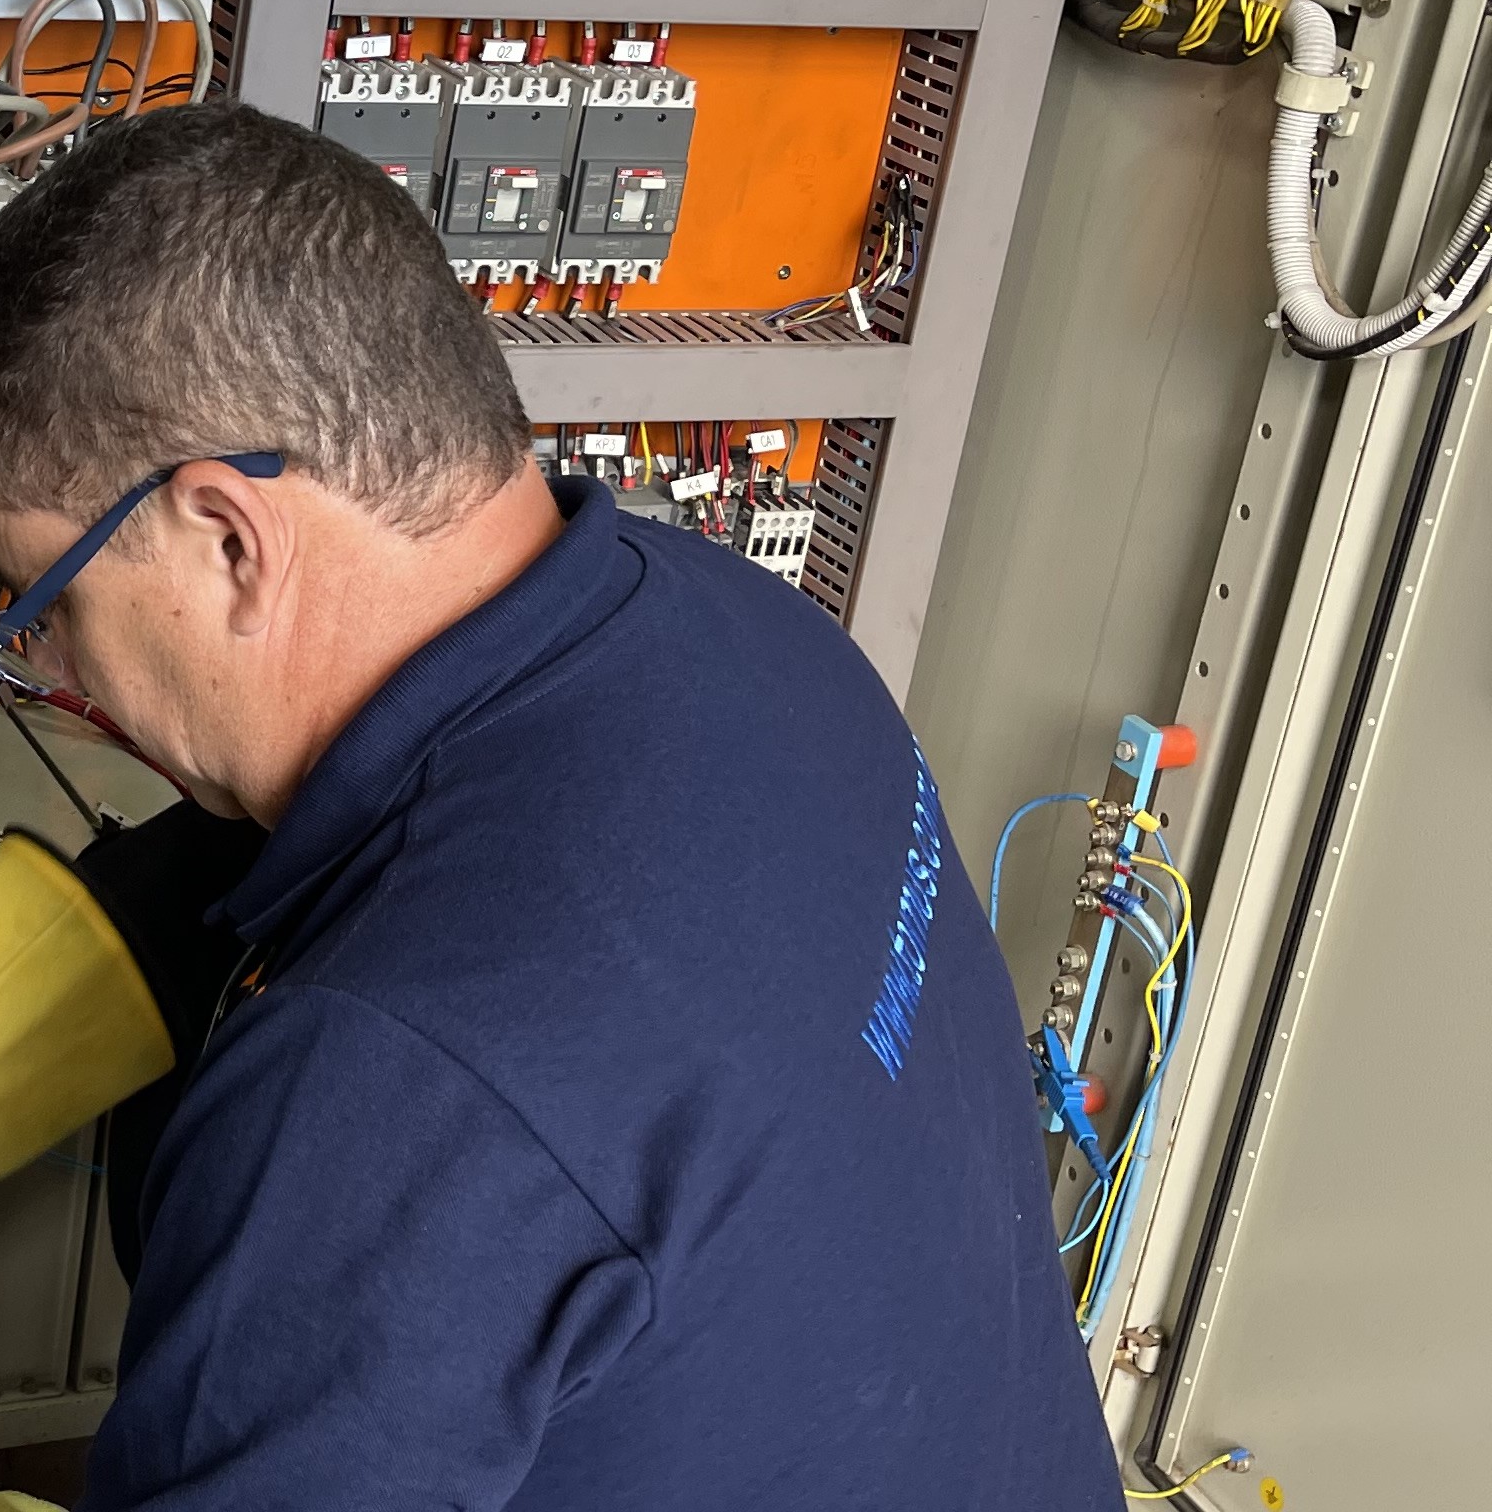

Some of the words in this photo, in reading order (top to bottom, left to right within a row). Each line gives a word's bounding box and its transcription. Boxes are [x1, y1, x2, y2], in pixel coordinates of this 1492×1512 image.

[361, 40, 376, 54] Q1
[496, 45, 513, 59] Q2
[627, 44, 641, 58] Q3
[760, 436, 775, 448] CA1
[687, 479, 703, 491] K4
